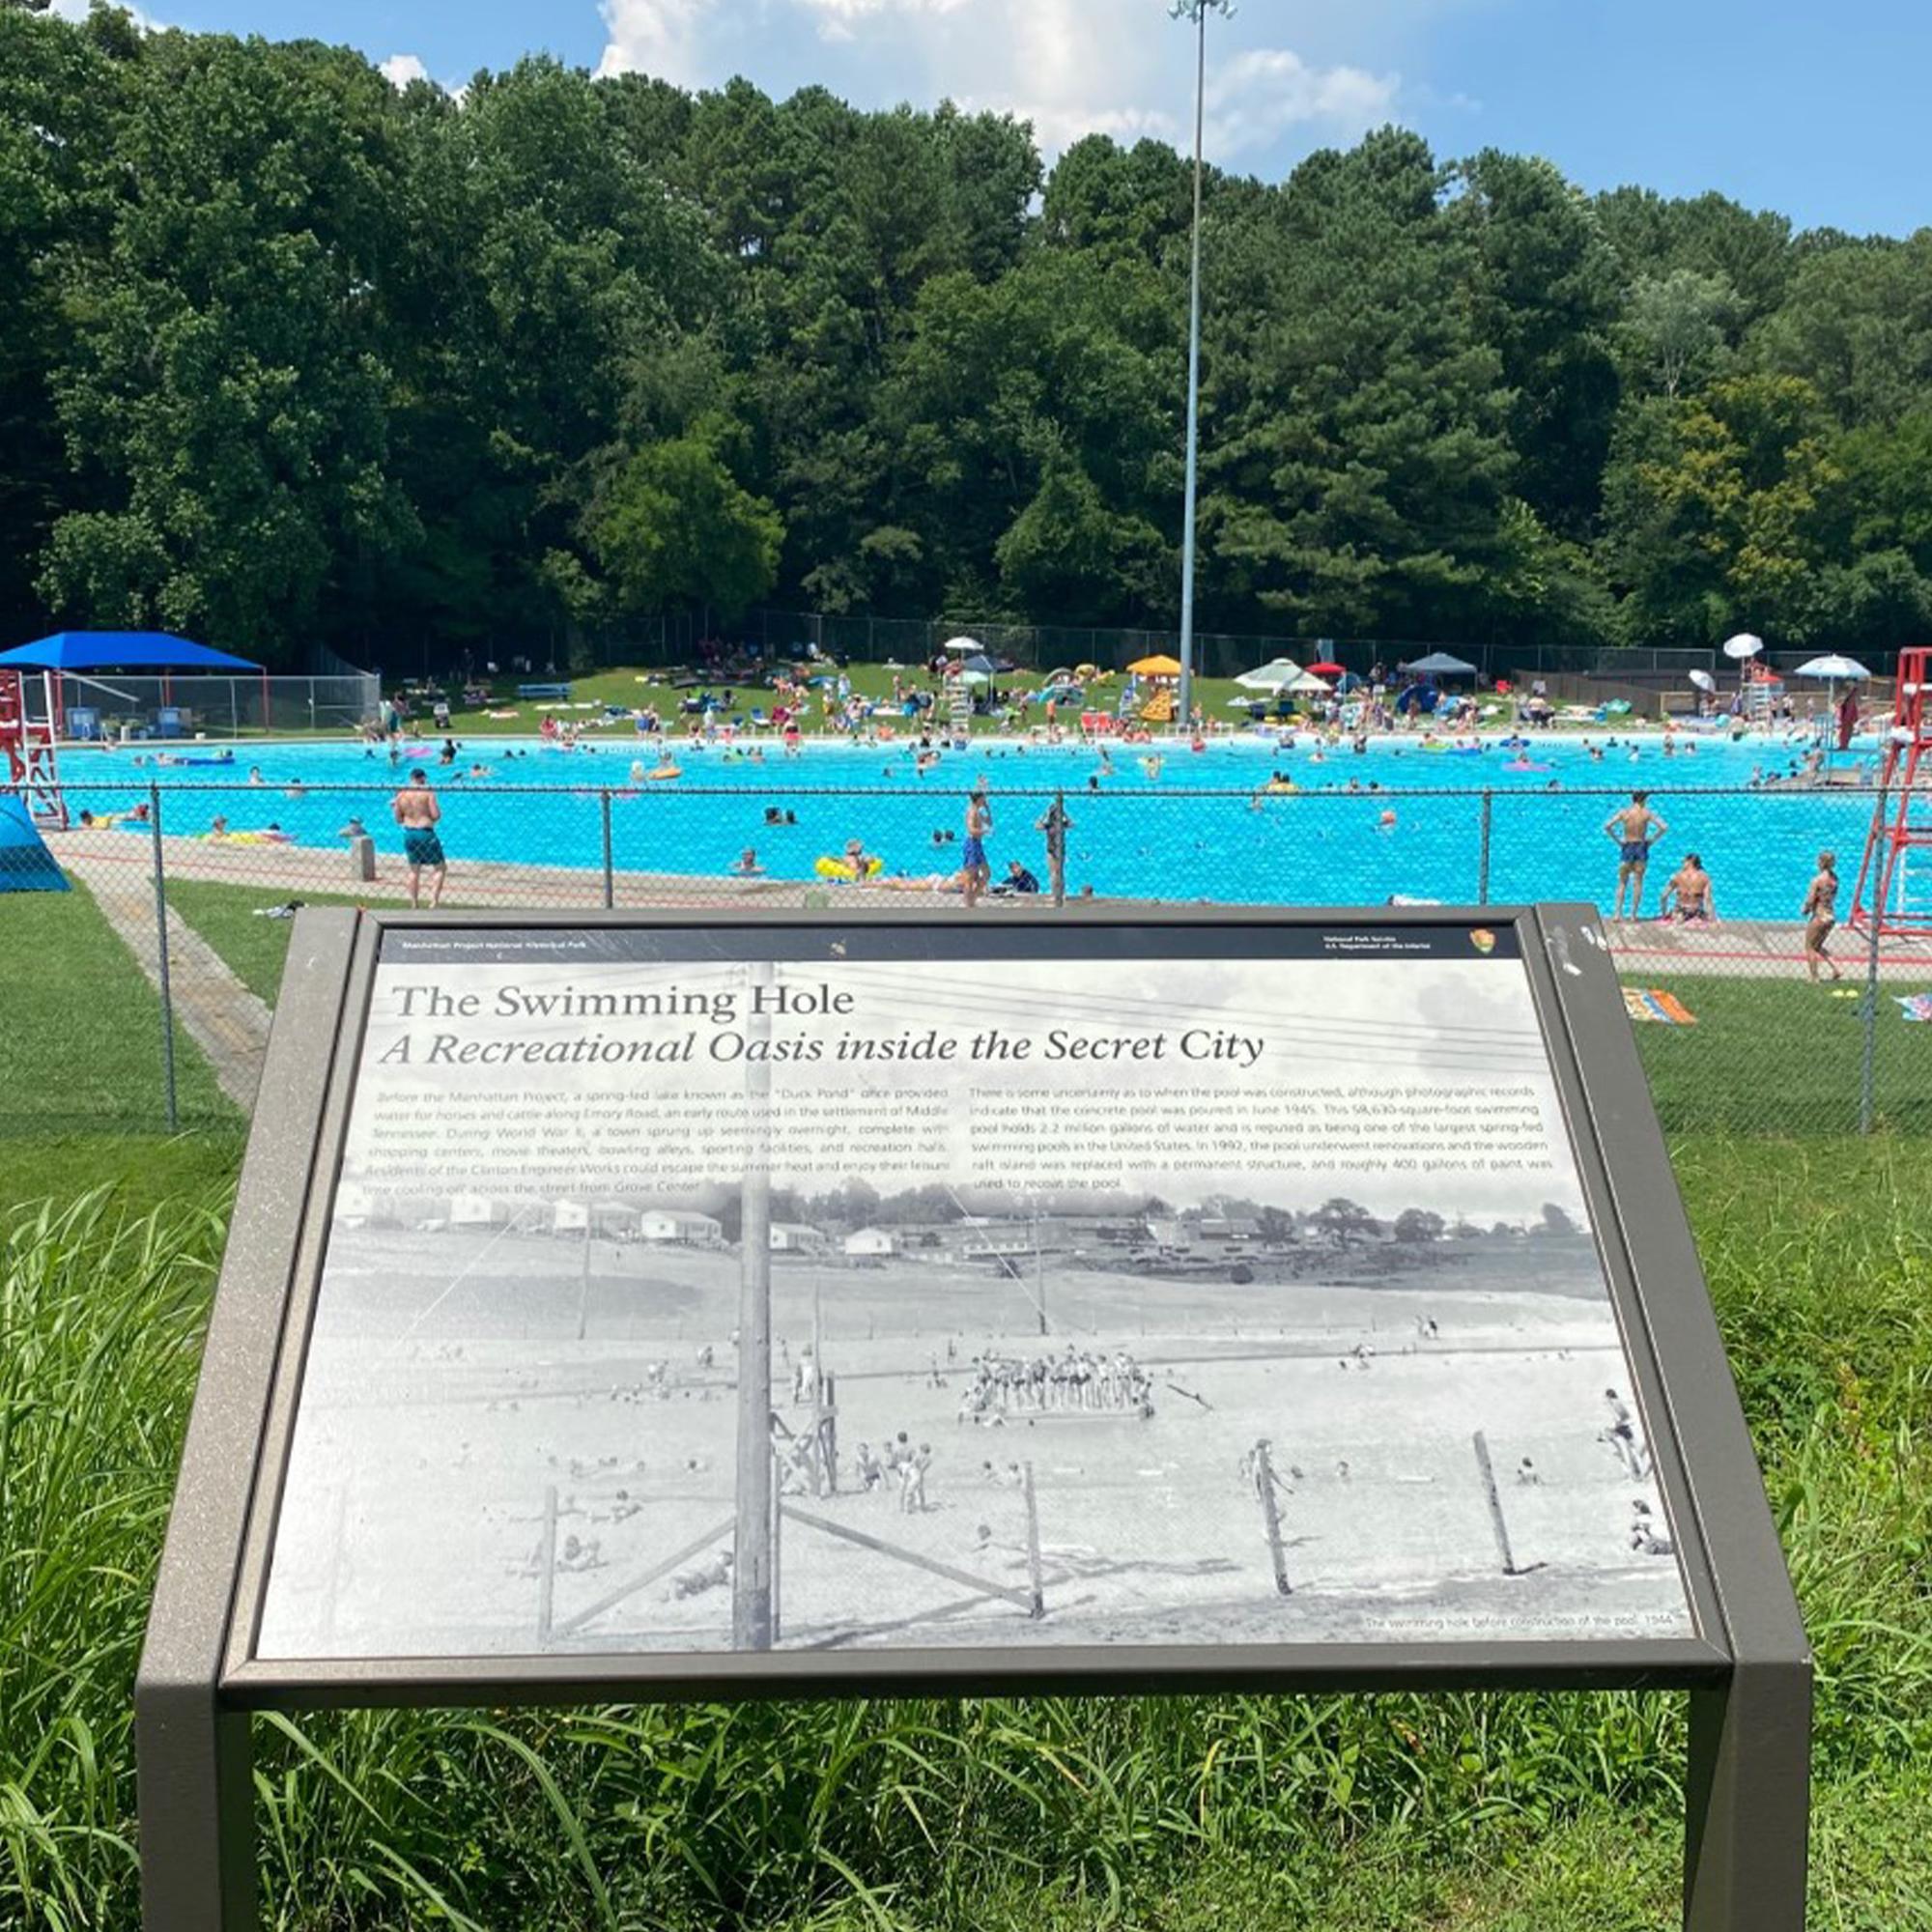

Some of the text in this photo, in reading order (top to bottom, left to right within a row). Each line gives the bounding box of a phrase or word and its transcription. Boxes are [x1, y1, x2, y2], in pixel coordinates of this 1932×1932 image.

[392, 983, 854, 1023] The Swimming Hole
[378, 1030, 1264, 1066] A Recreational Oasis inside the Secret City
[377, 1087, 949, 1104] Before the Manhattan spring-fed lake known the "Duck Pond" provided
[968, 1087, 1003, 1098] There
[1016, 1090, 1051, 1098] some
[1053, 1087, 1121, 1101] uncertainty
[1153, 1087, 1188, 1097] when
[1190, 1087, 1211, 1097] the
[1213, 1087, 1240, 1101] pool
[1347, 1086, 1403, 1100] although
[1405, 1086, 1488, 1100] photographic
[1488, 1086, 1536, 1097] records
[373, 1105, 949, 1122] water for horses and cattle along Emory early route used the settlement Middle
[968, 1103, 1540, 1119] indicate that the concrete pool was poured June This swimming
[446, 1127, 491, 1142] During
[497, 1126, 537, 1138] World
[543, 1126, 570, 1137] War
[607, 1125, 639, 1137] town
[647, 1128, 692, 1140] sprung
[721, 1125, 781, 1140] seemingly
[858, 1124, 916, 1139] complete
[968, 1122, 999, 1137] pool
[1001, 1122, 1036, 1133] holds
[1063, 1122, 1105, 1133] million
[1109, 1122, 1153, 1136] gallons
[1173, 1122, 1209, 1133] water
[1213, 1122, 1238, 1133] and
[1254, 1122, 1304, 1136] reputed
[1323, 1122, 1360, 1136] being
[1408, 1122, 1430, 1132] the
[1434, 1122, 1476, 1136] largest
[1478, 1122, 1544, 1136] spring-fed
[367, 1146, 429, 1160] shopping
[491, 1145, 529, 1155] movie
[599, 1144, 649, 1158] bowling
[701, 1143, 753, 1157] sporting
[819, 1142, 844, 1153] and
[850, 1142, 912, 1152] recreation
[970, 1139, 1548, 1154] swimming pools the United 1992, the pool underwent renovations and the wooden
[446, 1163, 468, 1175] the
[469, 1163, 518, 1175] Clinton
[522, 1163, 578, 1178] Engineer
[580, 1162, 620, 1174] Works
[622, 1162, 659, 1173] could
[661, 1165, 703, 1177] escape
[707, 1161, 728, 1173] the
[784, 1161, 813, 1172] heat
[815, 1160, 840, 1172] and
[842, 1160, 877, 1175] enjoy
[879, 1160, 908, 1171] their
[972, 1157, 1553, 1173] raft island was replaced with permanent structure, and roughly gallons paint was
[394, 1183, 442, 1198] cooling
[446, 1182, 466, 1194] off
[514, 1181, 537, 1193] the
[539, 1181, 576, 1193] street
[580, 1181, 611, 1192] from
[612, 1180, 651, 1192] Grove
[974, 1178, 1088, 1189] used recoat the
